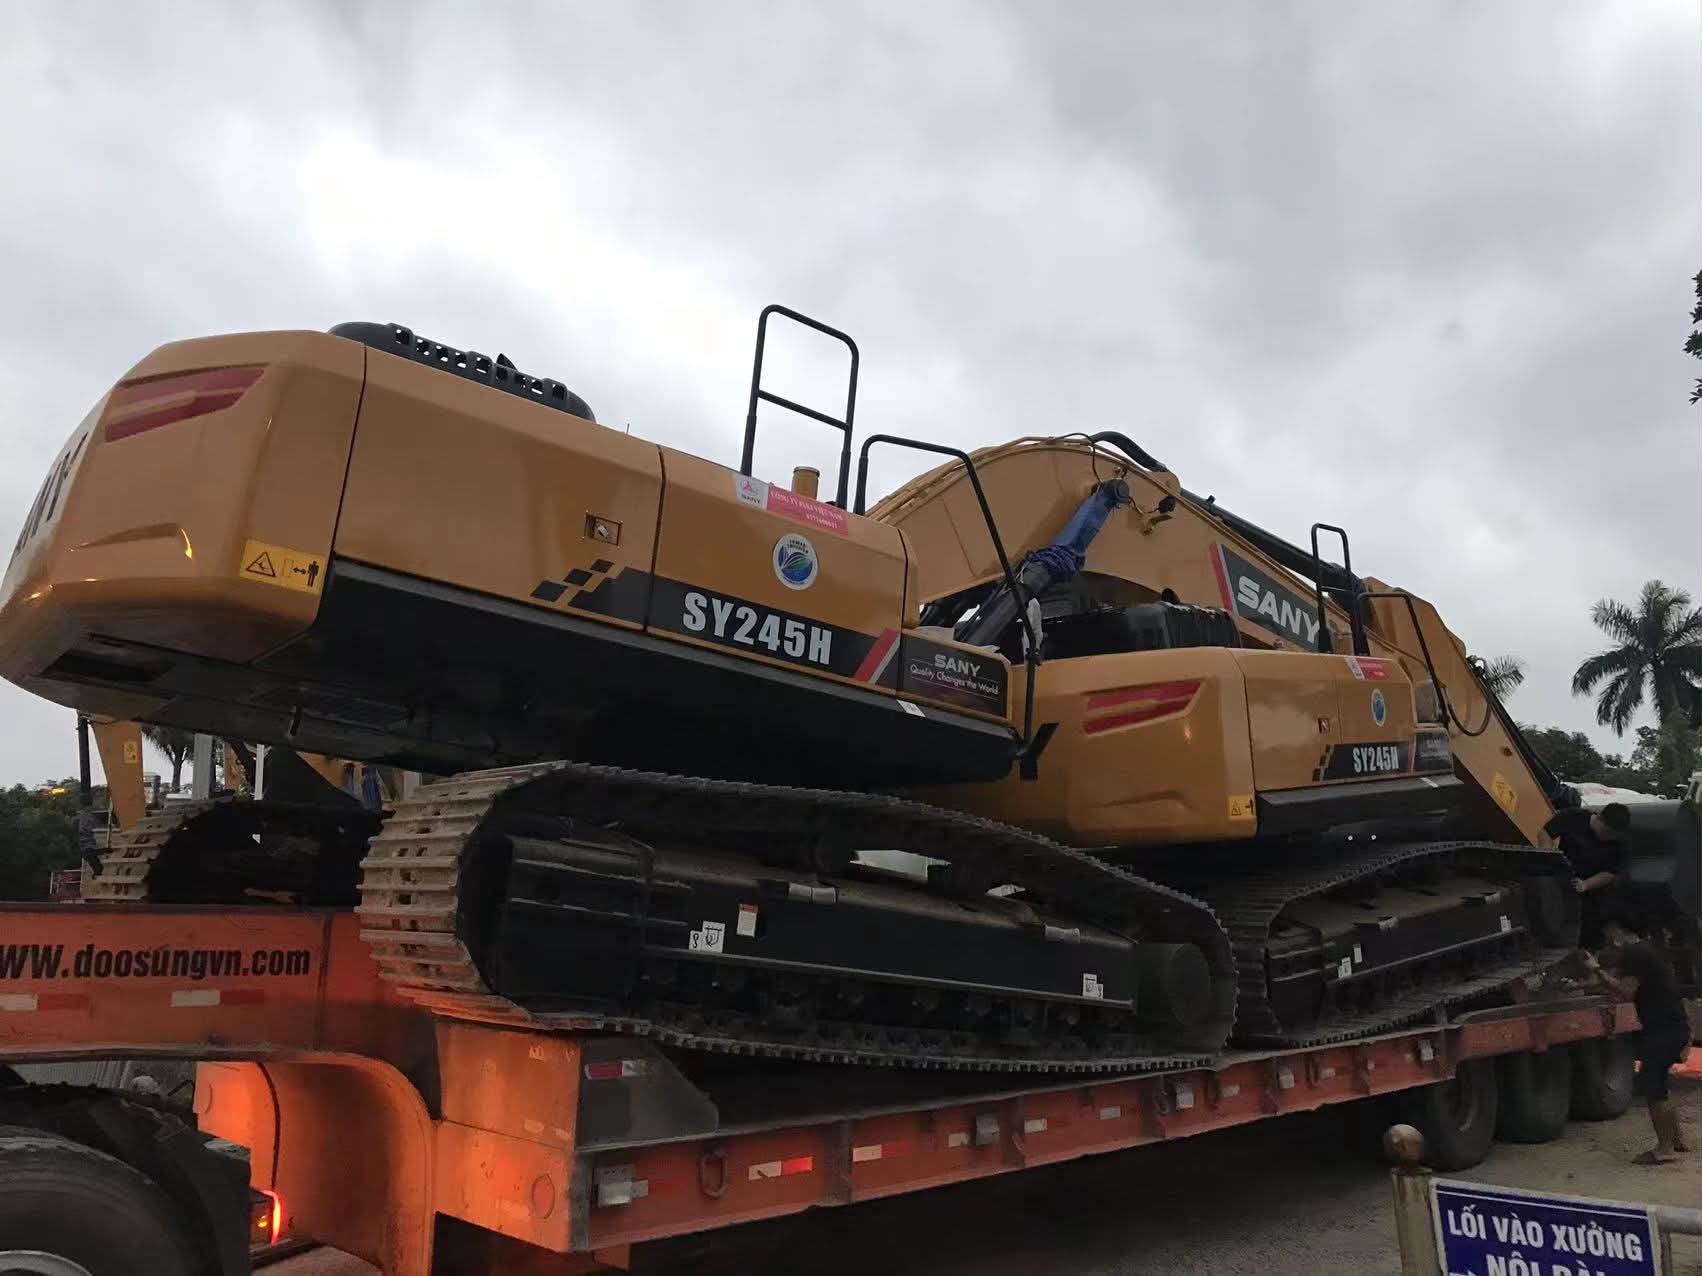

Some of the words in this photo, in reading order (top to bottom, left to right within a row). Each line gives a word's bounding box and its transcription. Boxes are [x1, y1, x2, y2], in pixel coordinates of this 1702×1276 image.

[683, 592, 832, 665] SY245H
[1238, 576, 1320, 644] SANY
[910, 664, 935, 680] Quality
[936, 672, 966, 688] Changes
[978, 683, 999, 695] World
[934, 654, 981, 677] SANY
[1352, 746, 1400, 773] SY245H
[1447, 1204, 1487, 1240] LỐI
[1491, 1211, 1545, 1248] VÀO
[1551, 1220, 1643, 1262] XƯỞNG
